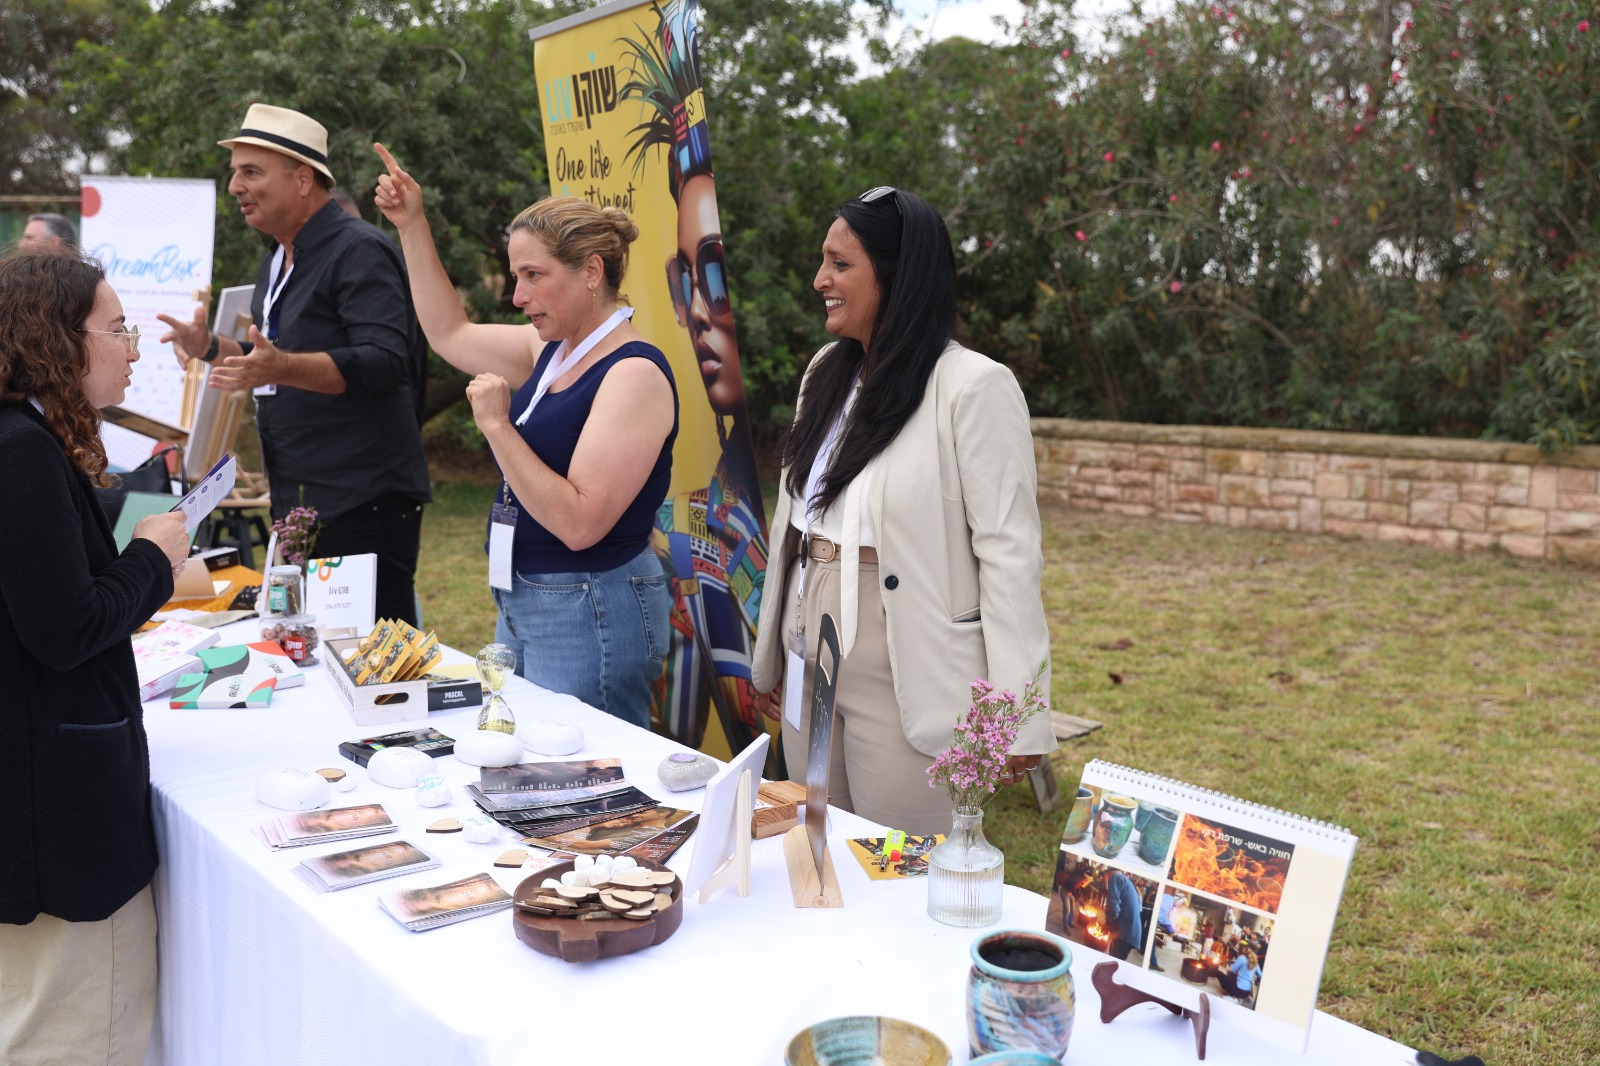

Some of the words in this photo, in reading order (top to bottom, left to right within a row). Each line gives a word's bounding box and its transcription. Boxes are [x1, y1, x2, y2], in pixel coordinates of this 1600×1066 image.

[556, 146, 587, 182] One
[589, 139, 613, 180] life
[444, 690, 464, 699] PASCAL
[1217, 832, 1243, 846] שרפת
[1268, 847, 1291, 860] חוויה
